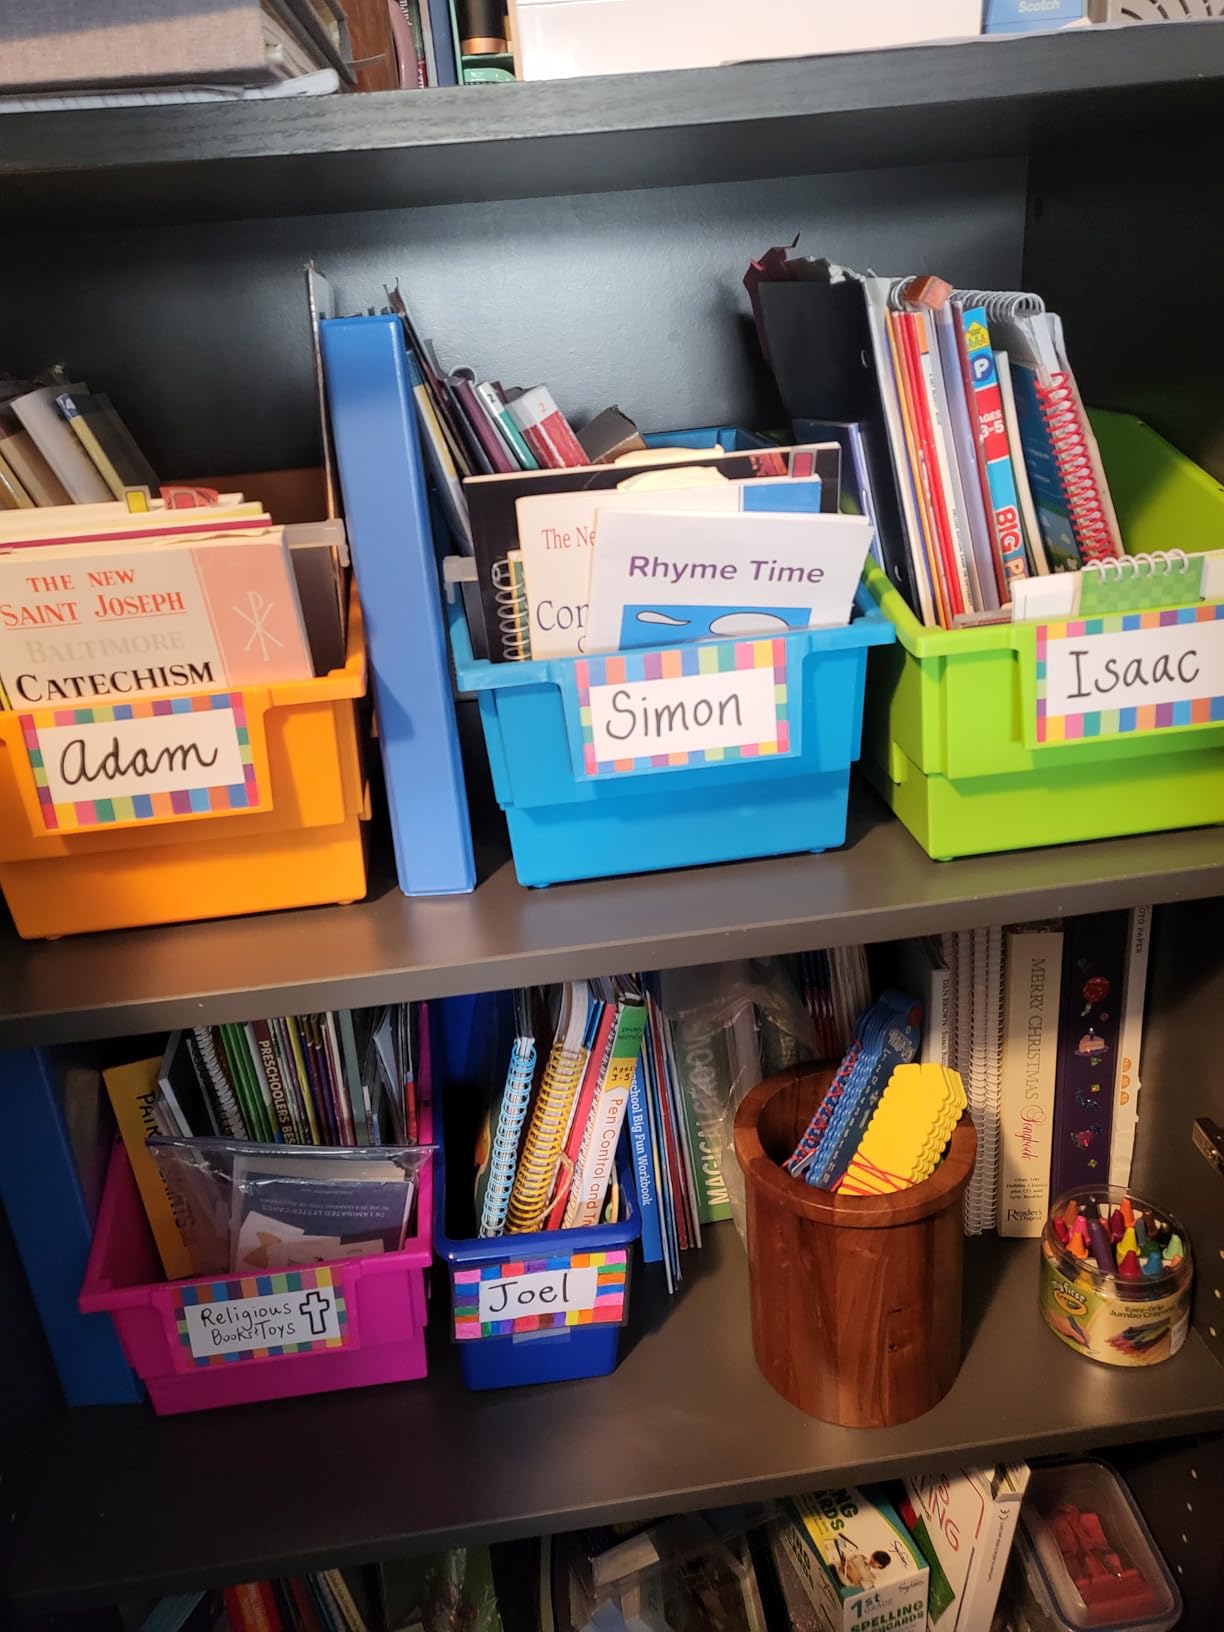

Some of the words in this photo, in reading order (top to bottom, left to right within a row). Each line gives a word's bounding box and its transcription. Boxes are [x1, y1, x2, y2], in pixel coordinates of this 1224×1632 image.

[1018, 1, 1060, 13] Scotch
[541, 527, 571, 549] The
[996, 505, 1022, 554] BIG
[26, 573, 74, 593] THE
[87, 569, 135, 588] NEW
[628, 555, 737, 584] Rhyme
[749, 560, 824, 583] Time
[0, 602, 79, 627] SAINT
[95, 591, 186, 618] JOSEPH
[26, 631, 186, 665] BALTIMORE
[16, 661, 215, 702] CATECHISM
[1067, 650, 1200, 699] Isaac
[605, 689, 742, 740] Simon
[61, 737, 218, 785] Adam
[1029, 957, 1046, 1012] MERRY
[1024, 1015, 1043, 1100] CHRISTMAS
[258, 1039, 291, 1124] PRESCHOOLERS
[606, 1099, 623, 1124] Pen
[632, 1115, 644, 1133] Big
[594, 1128, 615, 1179] Control
[635, 1134, 646, 1154] Fun
[585, 1184, 600, 1209] and
[637, 1154, 653, 1206] Workbook
[488, 1273, 569, 1312] Joel
[201, 1303, 291, 1331] Religious
[1109, 1309, 1142, 1319] Jumbo
[850, 1593, 881, 1618] 1st
[850, 1600, 924, 1632] SPELLING
